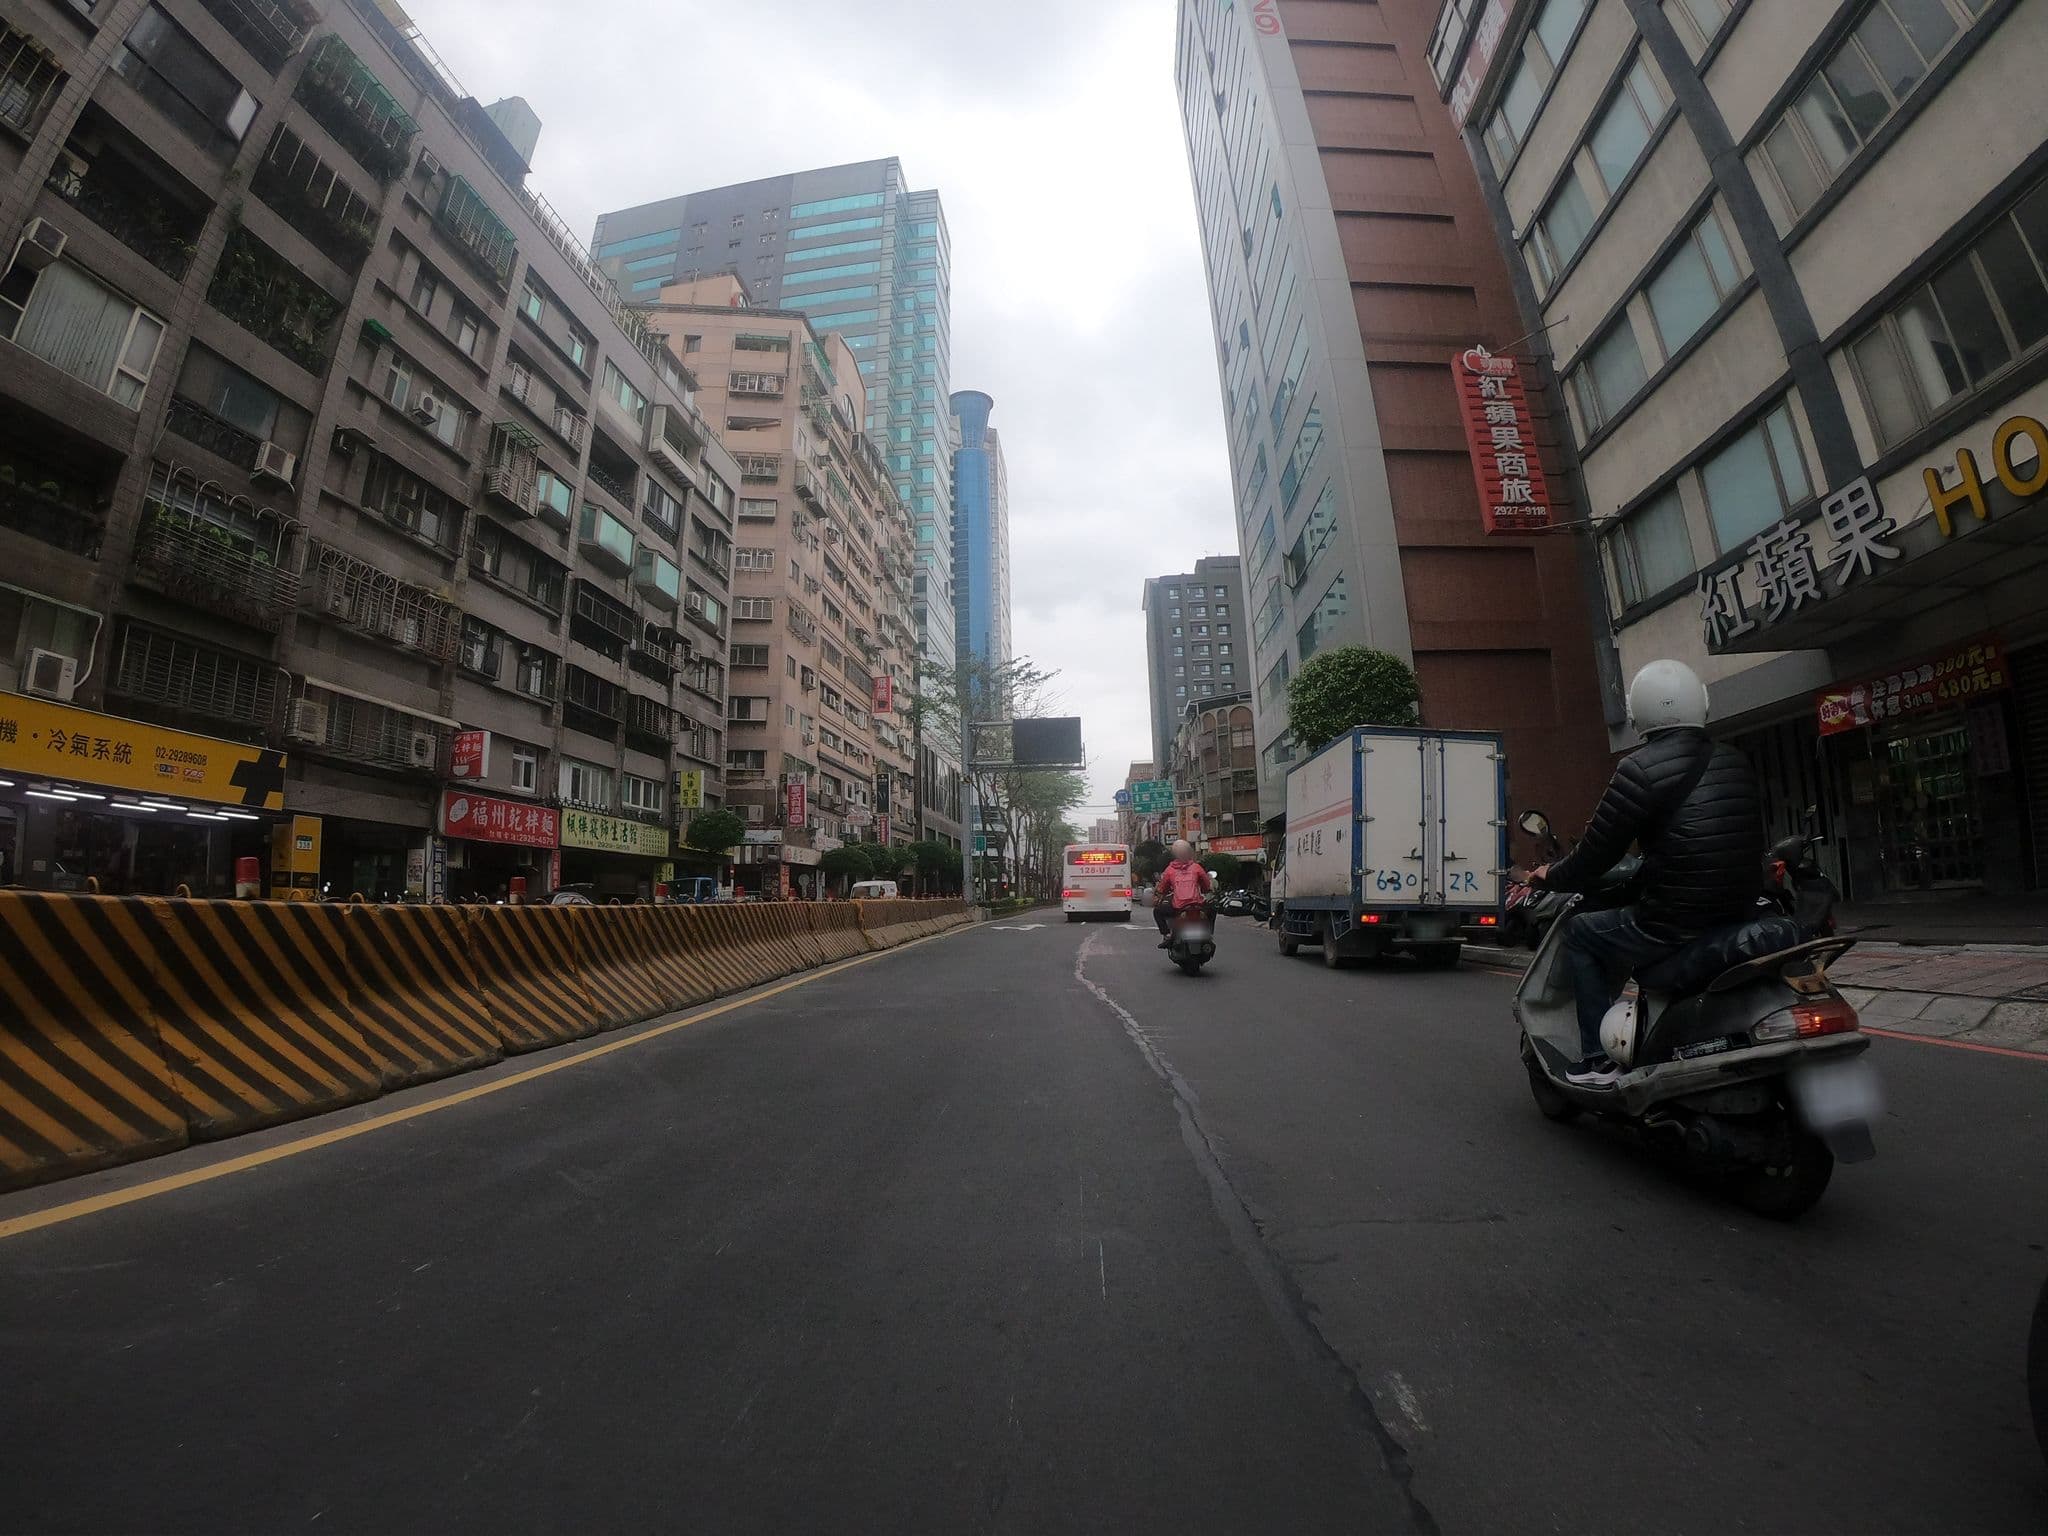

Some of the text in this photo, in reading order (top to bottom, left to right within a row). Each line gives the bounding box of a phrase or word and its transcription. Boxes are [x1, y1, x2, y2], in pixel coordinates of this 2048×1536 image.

[1477, 376, 1536, 504] 紅蘋果商旅
[1493, 504, 1547, 516] 2927-9118
[1695, 474, 1905, 648] 紅蘋果
[472, 799, 554, 837] 福州乾拌麵
